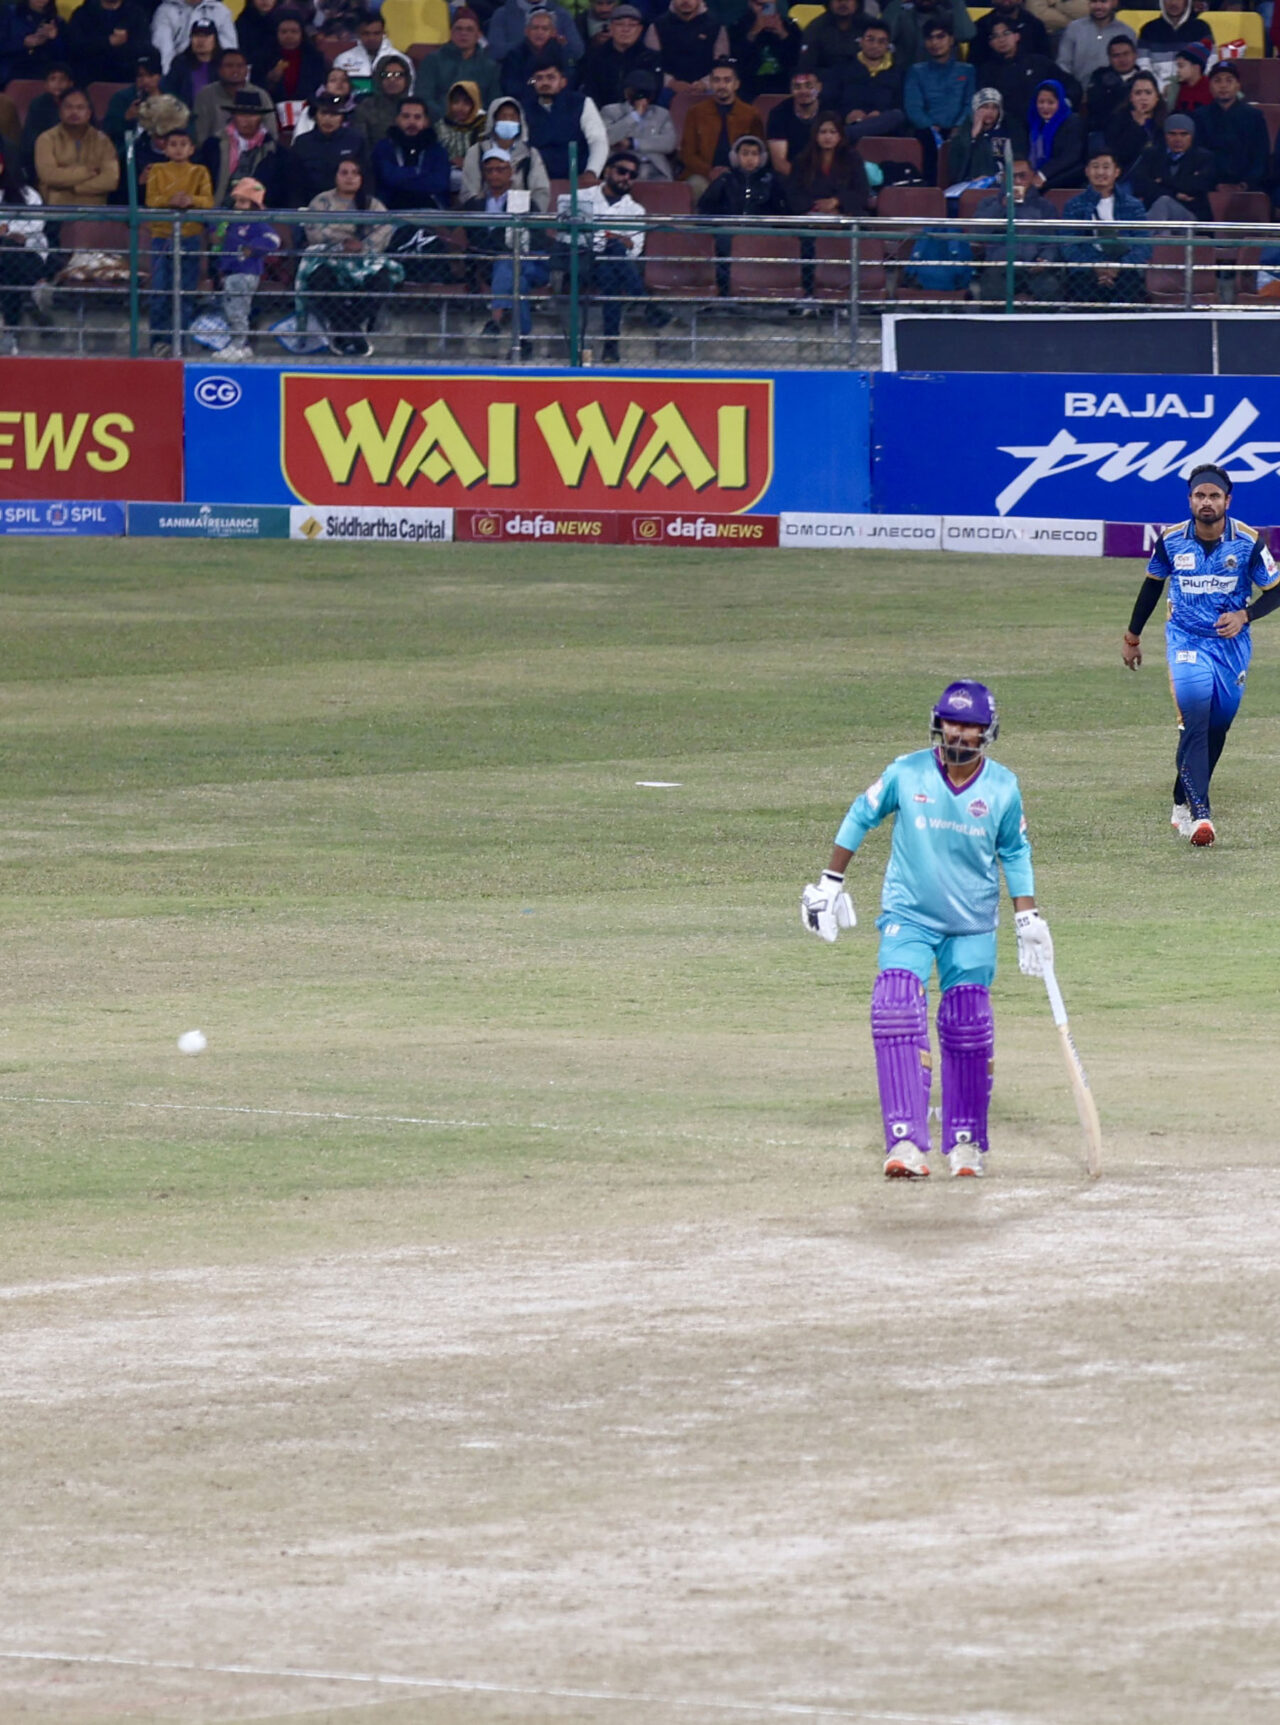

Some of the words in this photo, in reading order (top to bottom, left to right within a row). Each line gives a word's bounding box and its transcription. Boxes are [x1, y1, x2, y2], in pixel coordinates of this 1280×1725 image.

[199, 383, 237, 402] CG
[1064, 392, 1215, 420] BAJAJ
[303, 396, 518, 489] WAI
[534, 399, 749, 493] WAI
[4, 506, 41, 523] SPIL
[70, 506, 107, 522] SPIL
[158, 517, 203, 529] SANIMA
[326, 515, 397, 539] Siddhartha
[399, 518, 446, 543] Capital
